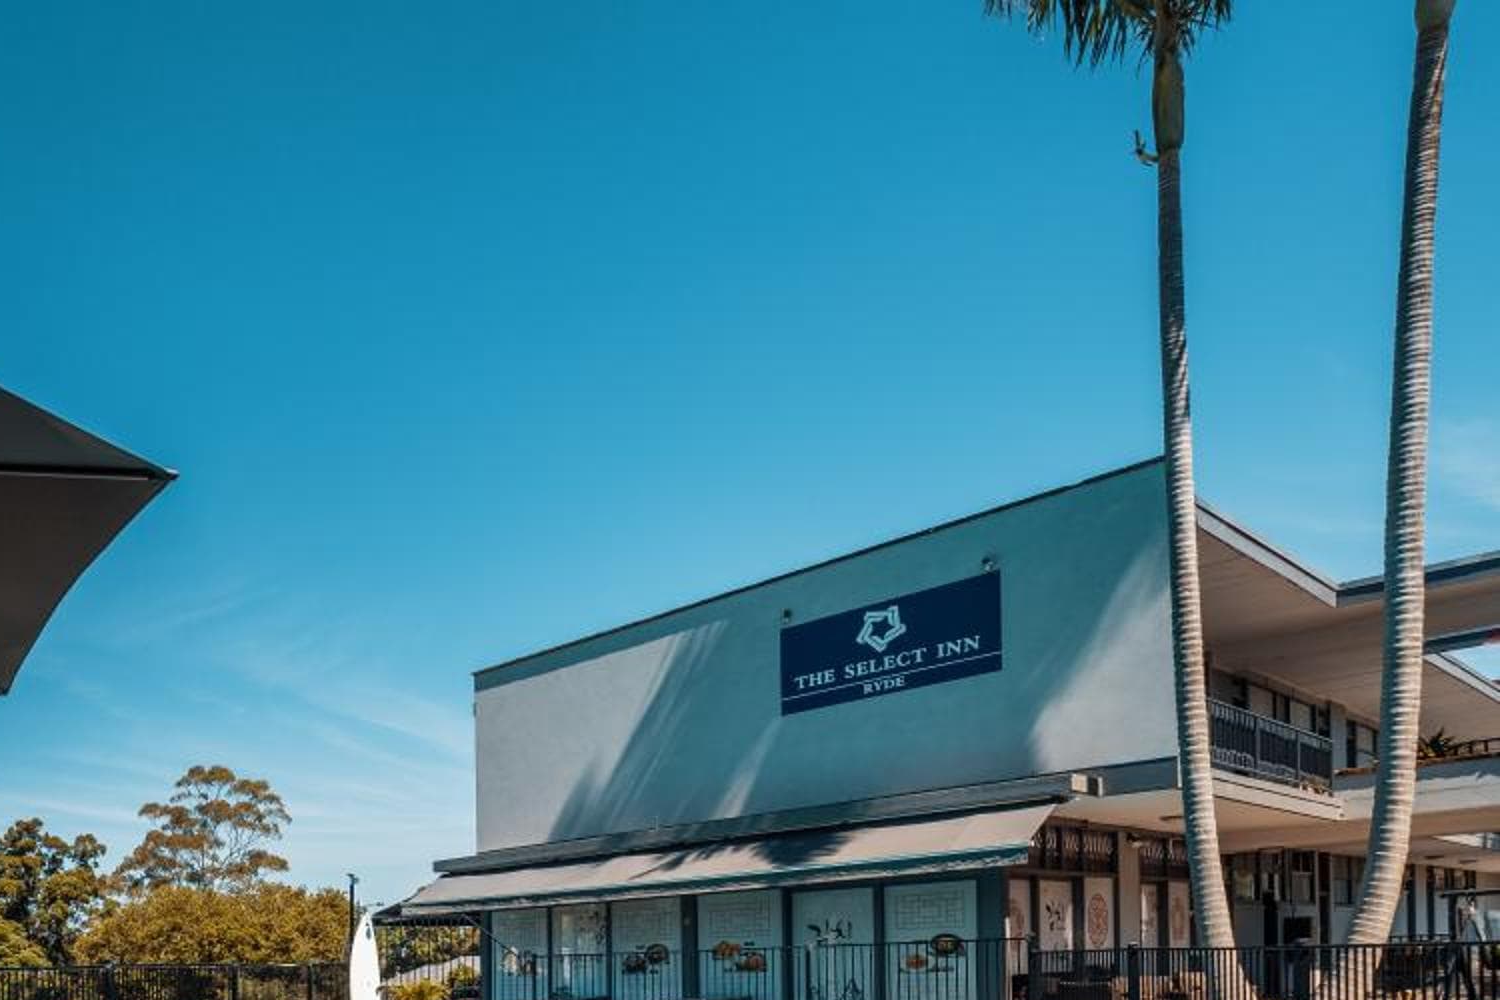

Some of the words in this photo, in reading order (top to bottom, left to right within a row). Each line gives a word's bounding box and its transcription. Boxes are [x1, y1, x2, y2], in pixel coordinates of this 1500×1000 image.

[794, 669, 835, 690] THE
[844, 647, 927, 679] SELECT
[936, 635, 981, 659] INN
[863, 675, 906, 695] RYDE
